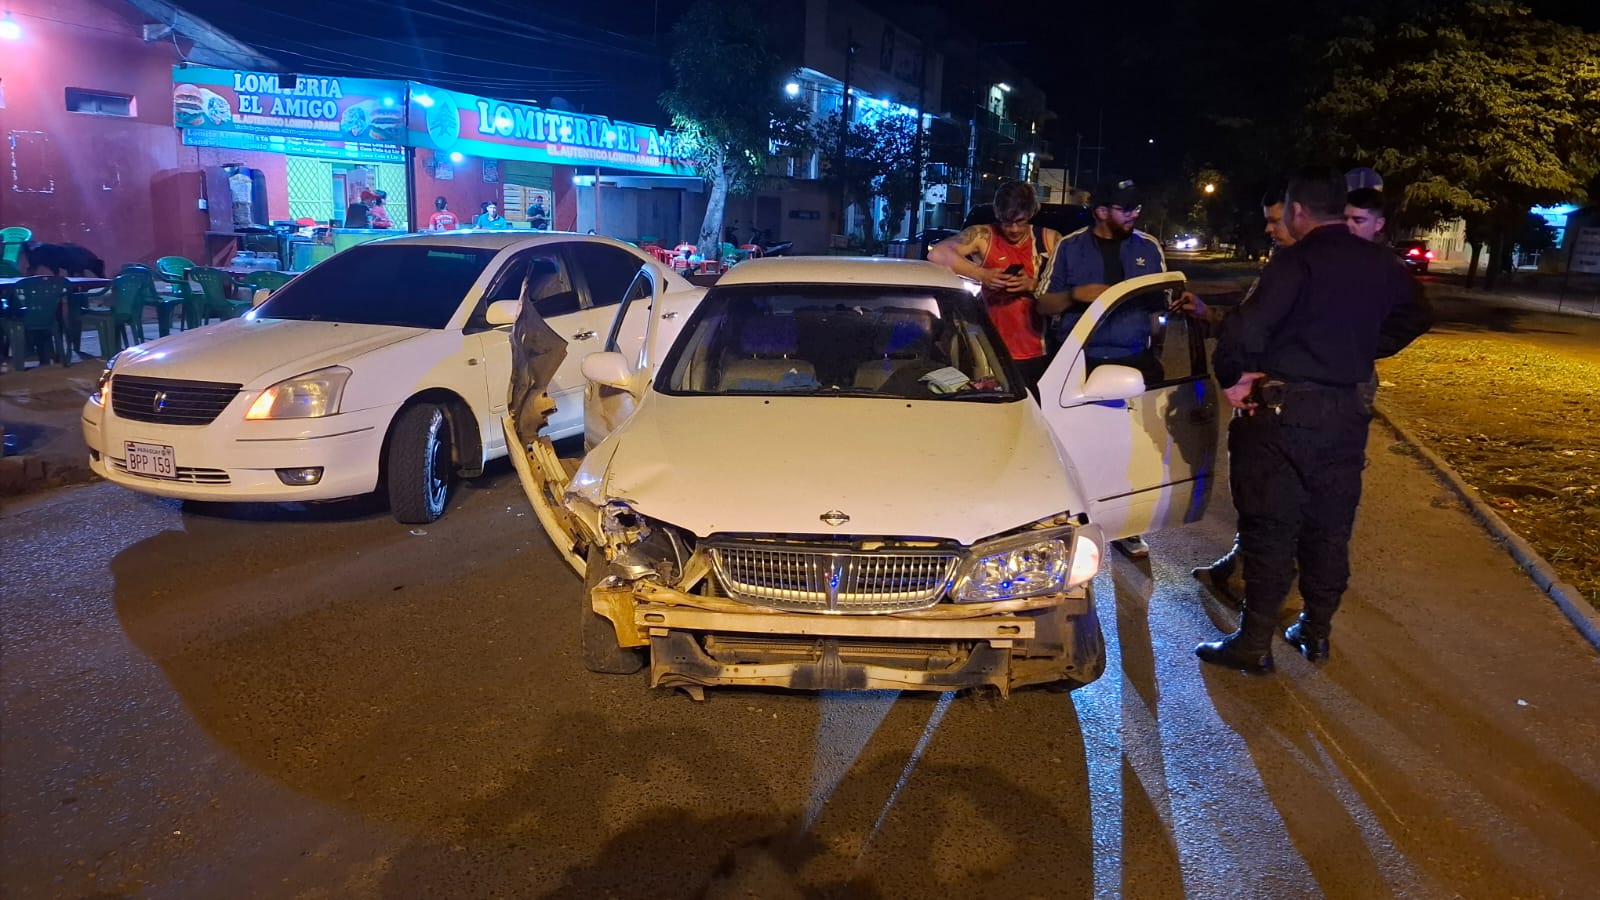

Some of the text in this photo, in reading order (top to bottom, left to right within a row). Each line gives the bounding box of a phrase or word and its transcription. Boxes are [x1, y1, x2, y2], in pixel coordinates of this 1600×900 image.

[234, 74, 342, 98] LOMIERIA
[238, 95, 337, 119] EL AMIGO
[232, 113, 243, 124] EL
[477, 101, 616, 149] LOMITERIA
[617, 126, 639, 153] EL
[547, 144, 559, 156] EL
[560, 146, 607, 162] AUTENTICO
[130, 453, 171, 474] BPP 159
